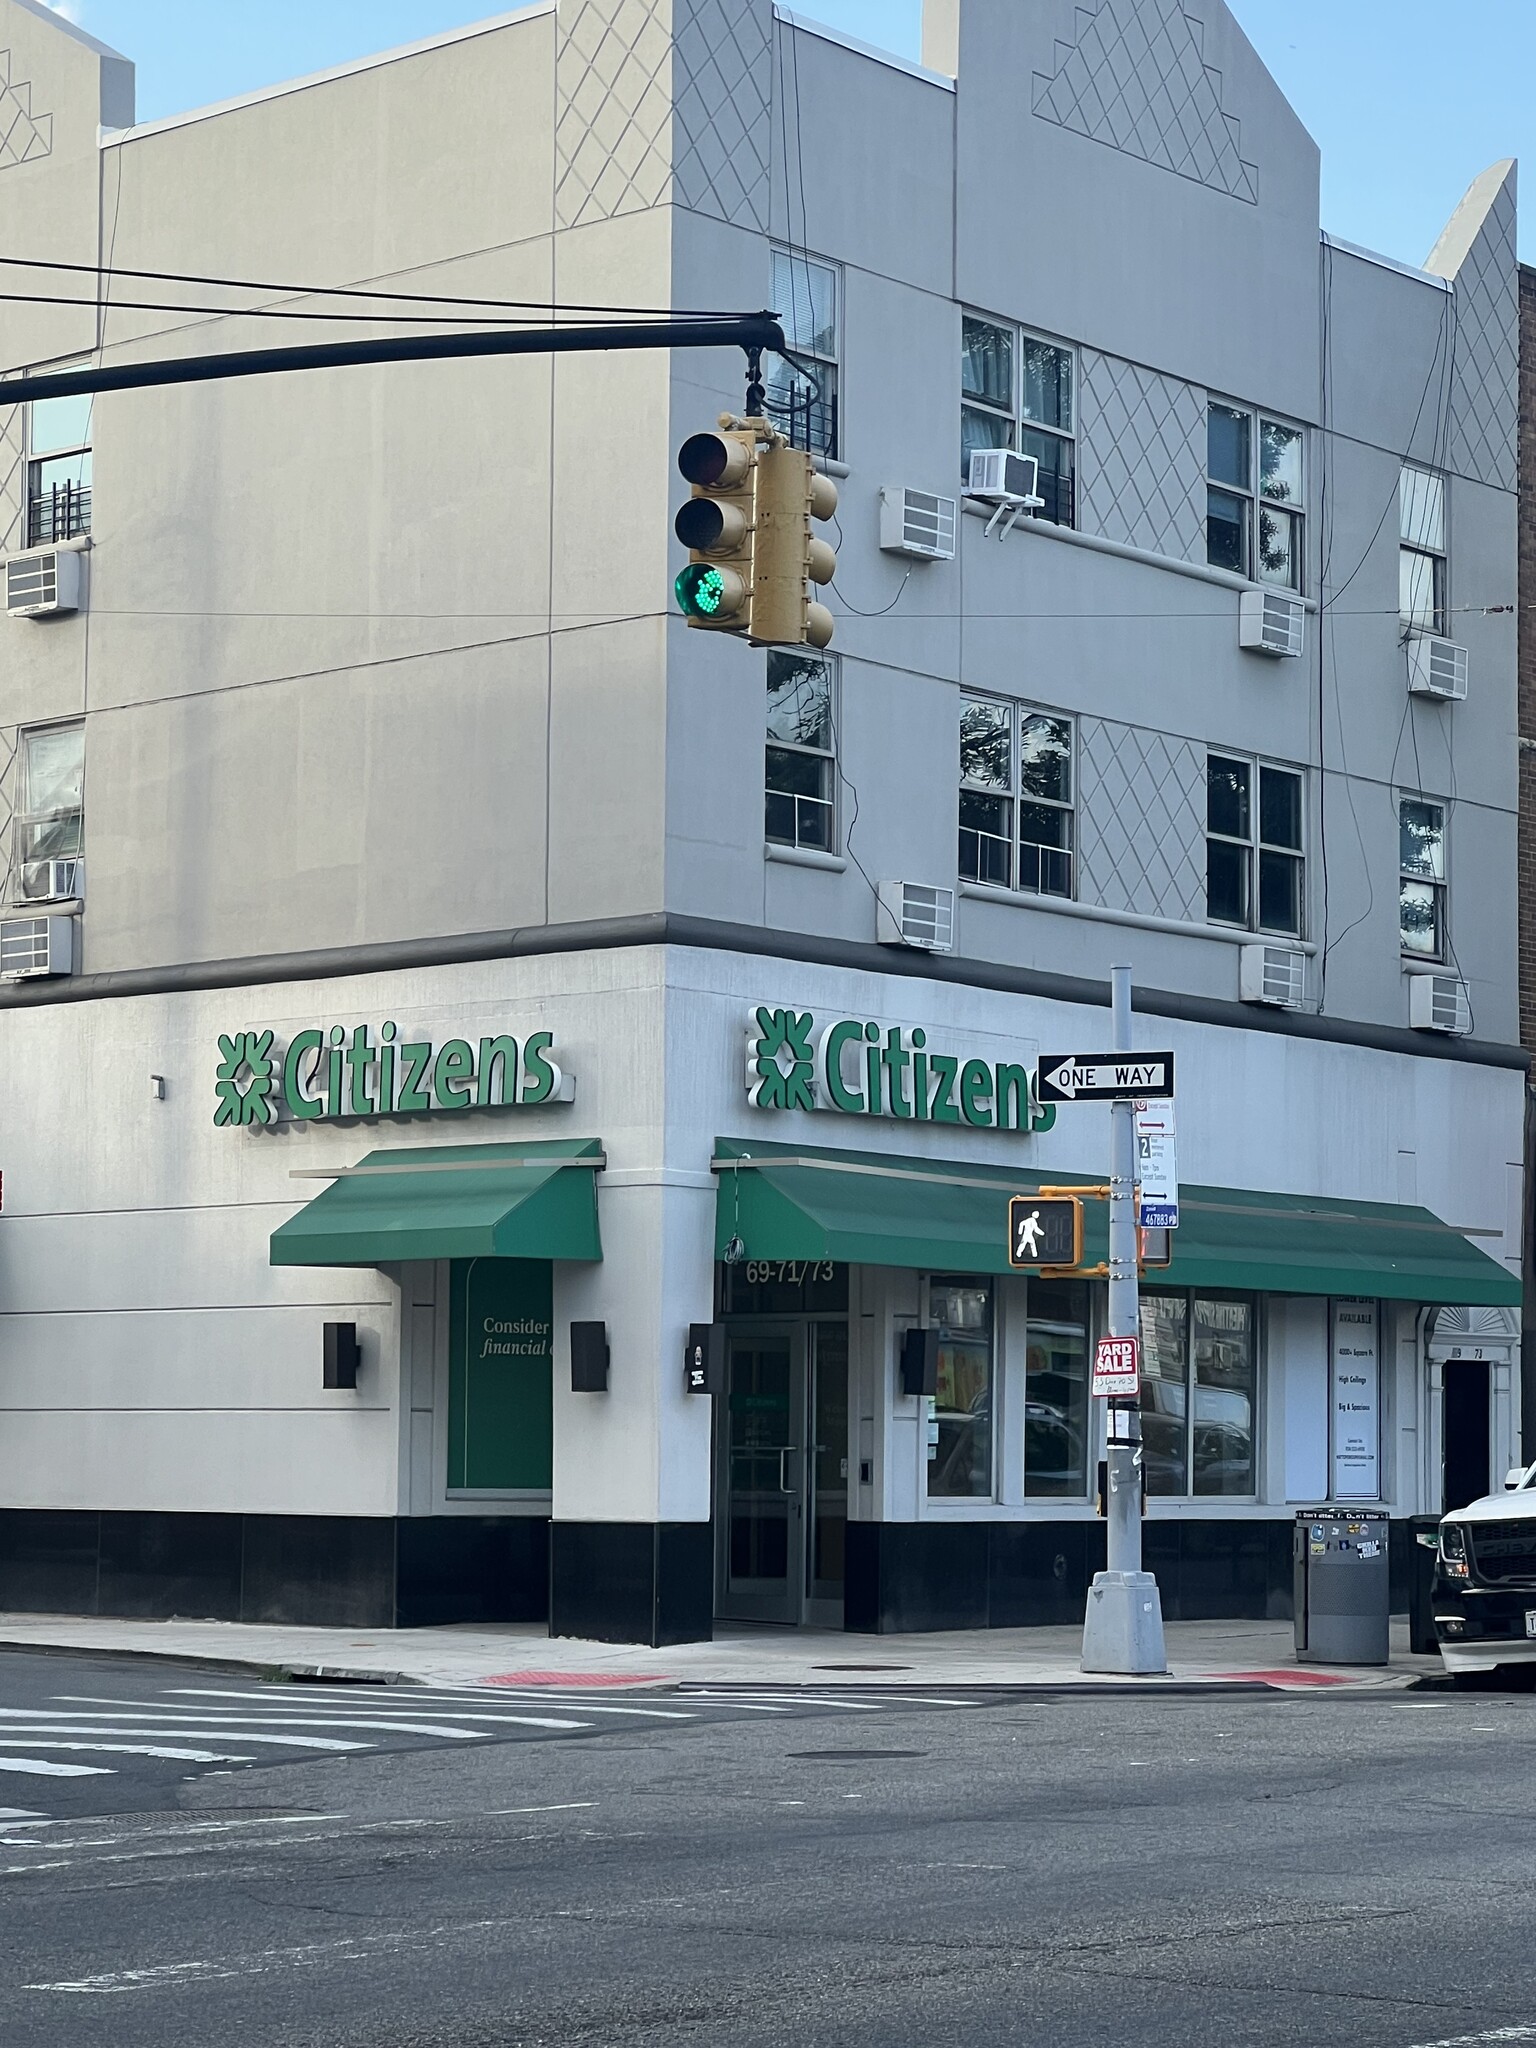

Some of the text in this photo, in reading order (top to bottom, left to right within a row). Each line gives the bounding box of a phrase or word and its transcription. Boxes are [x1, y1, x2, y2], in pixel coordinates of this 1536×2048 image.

[284, 1020, 558, 1119] Citizens
[1059, 1066, 1156, 1087] ONE WAY
[1141, 1137, 1149, 1157] 2
[746, 1261, 834, 1287] 69-71/73
[483, 1317, 550, 1335] Consider
[1339, 1313, 1372, 1324] AVAILABLE
[480, 1338, 547, 1358] financial
[1098, 1343, 1133, 1357] YARD
[1097, 1355, 1133, 1373] SALE
